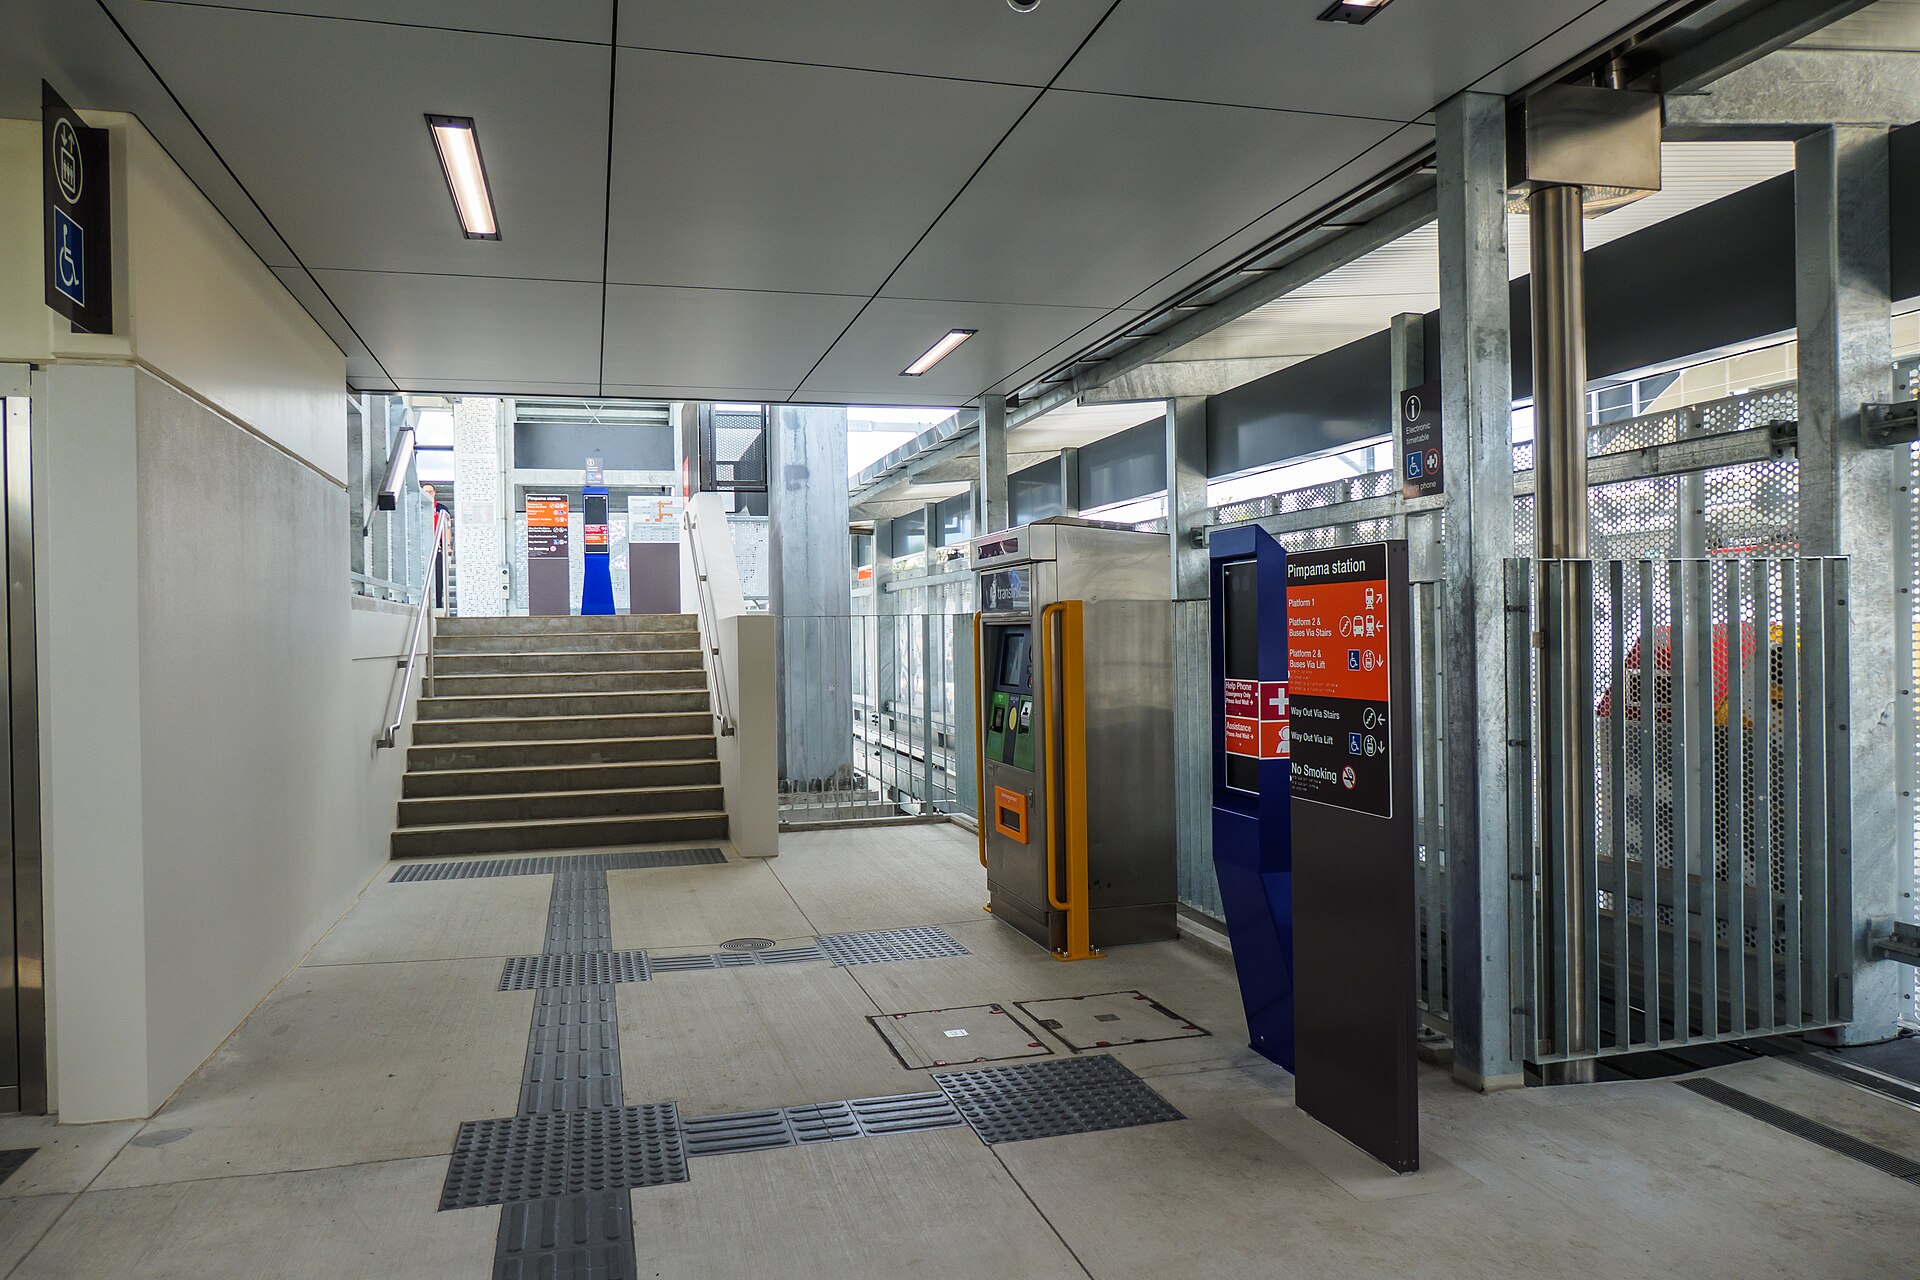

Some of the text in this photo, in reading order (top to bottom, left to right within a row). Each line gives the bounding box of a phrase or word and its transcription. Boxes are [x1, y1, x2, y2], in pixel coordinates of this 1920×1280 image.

[1406, 422, 1431, 434] Electronic
[1406, 434, 1429, 445] timetable
[1420, 481, 1436, 490] phone
[1287, 558, 1366, 579] Pimpama station
[1317, 617, 1321, 625] &
[1316, 628, 1332, 636] Stairs
[1290, 649, 1311, 657] Platform
[1316, 660, 1325, 669] Lift
[1225, 682, 1252, 691] Help Phone
[1291, 707, 1340, 720] Way Out Via Stairs
[1226, 721, 1252, 732] Assistance
[1291, 731, 1334, 745] Way Out Via Lift
[1292, 762, 1337, 784] No Smoking
